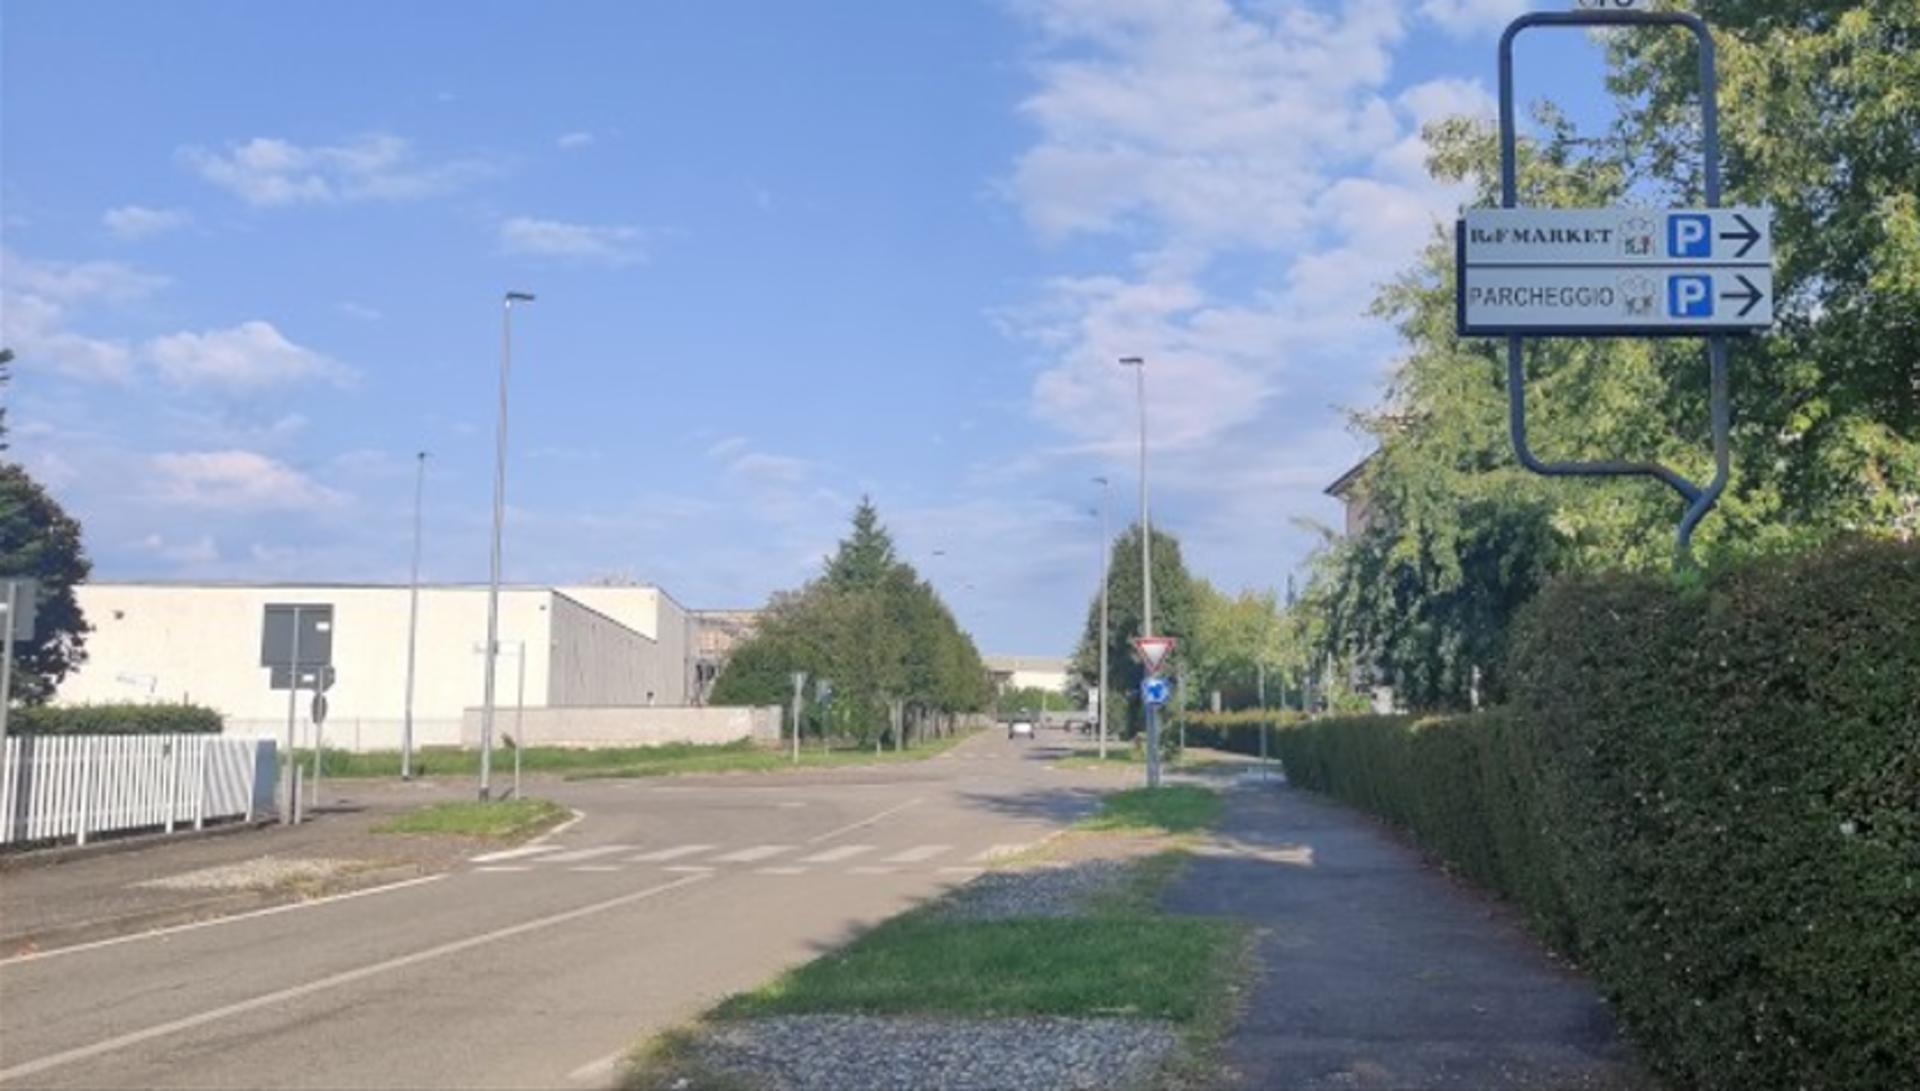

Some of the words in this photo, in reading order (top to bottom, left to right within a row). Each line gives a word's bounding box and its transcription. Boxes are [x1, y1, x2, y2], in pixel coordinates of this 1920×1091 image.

[1512, 229, 1613, 243] MARKET
[1677, 218, 1704, 254] P
[1470, 286, 1615, 308] PARCHEGGIO
[1677, 278, 1706, 314] P
